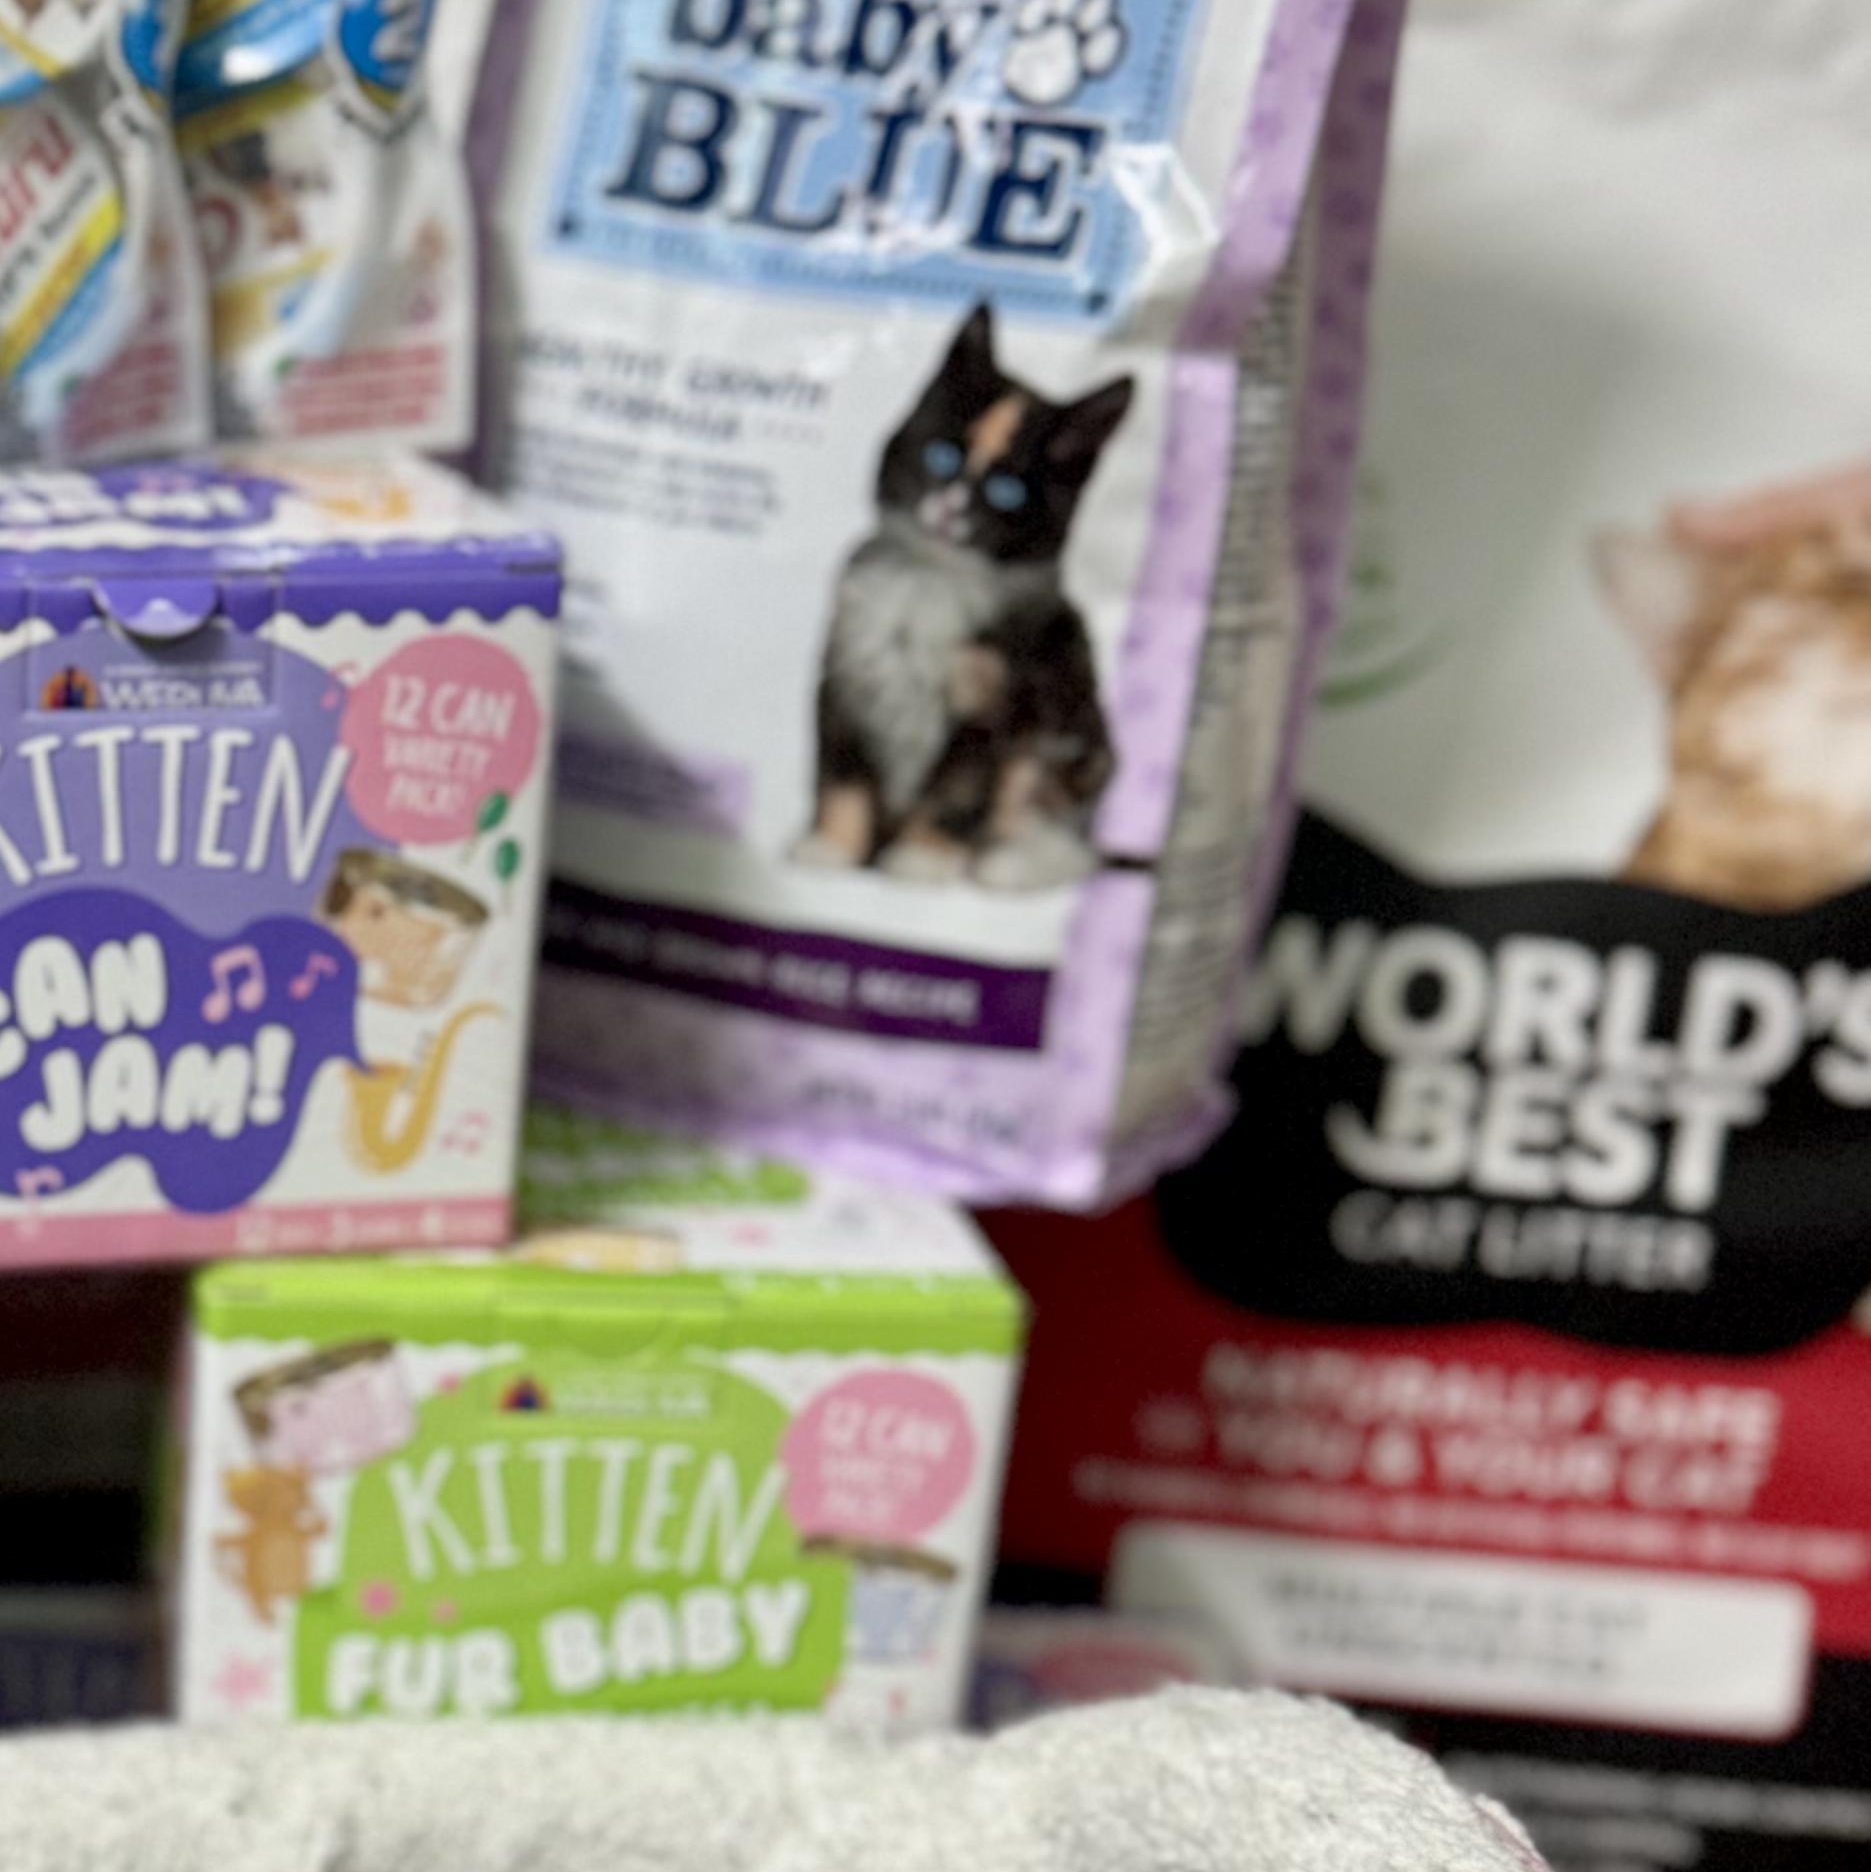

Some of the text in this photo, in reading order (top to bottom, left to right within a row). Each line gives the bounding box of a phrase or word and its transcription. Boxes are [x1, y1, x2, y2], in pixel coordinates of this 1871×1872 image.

[604, 70, 1113, 260] BLUE
[382, 675, 518, 741] 12 CAN
[19, 1024, 295, 1153] JAM!
[1326, 1059, 1767, 1213] BEST
[1330, 1193, 1716, 1294] CAT LITTER
[388, 1439, 789, 1581] KITTEN
[330, 1579, 811, 1717] FUR BABY
